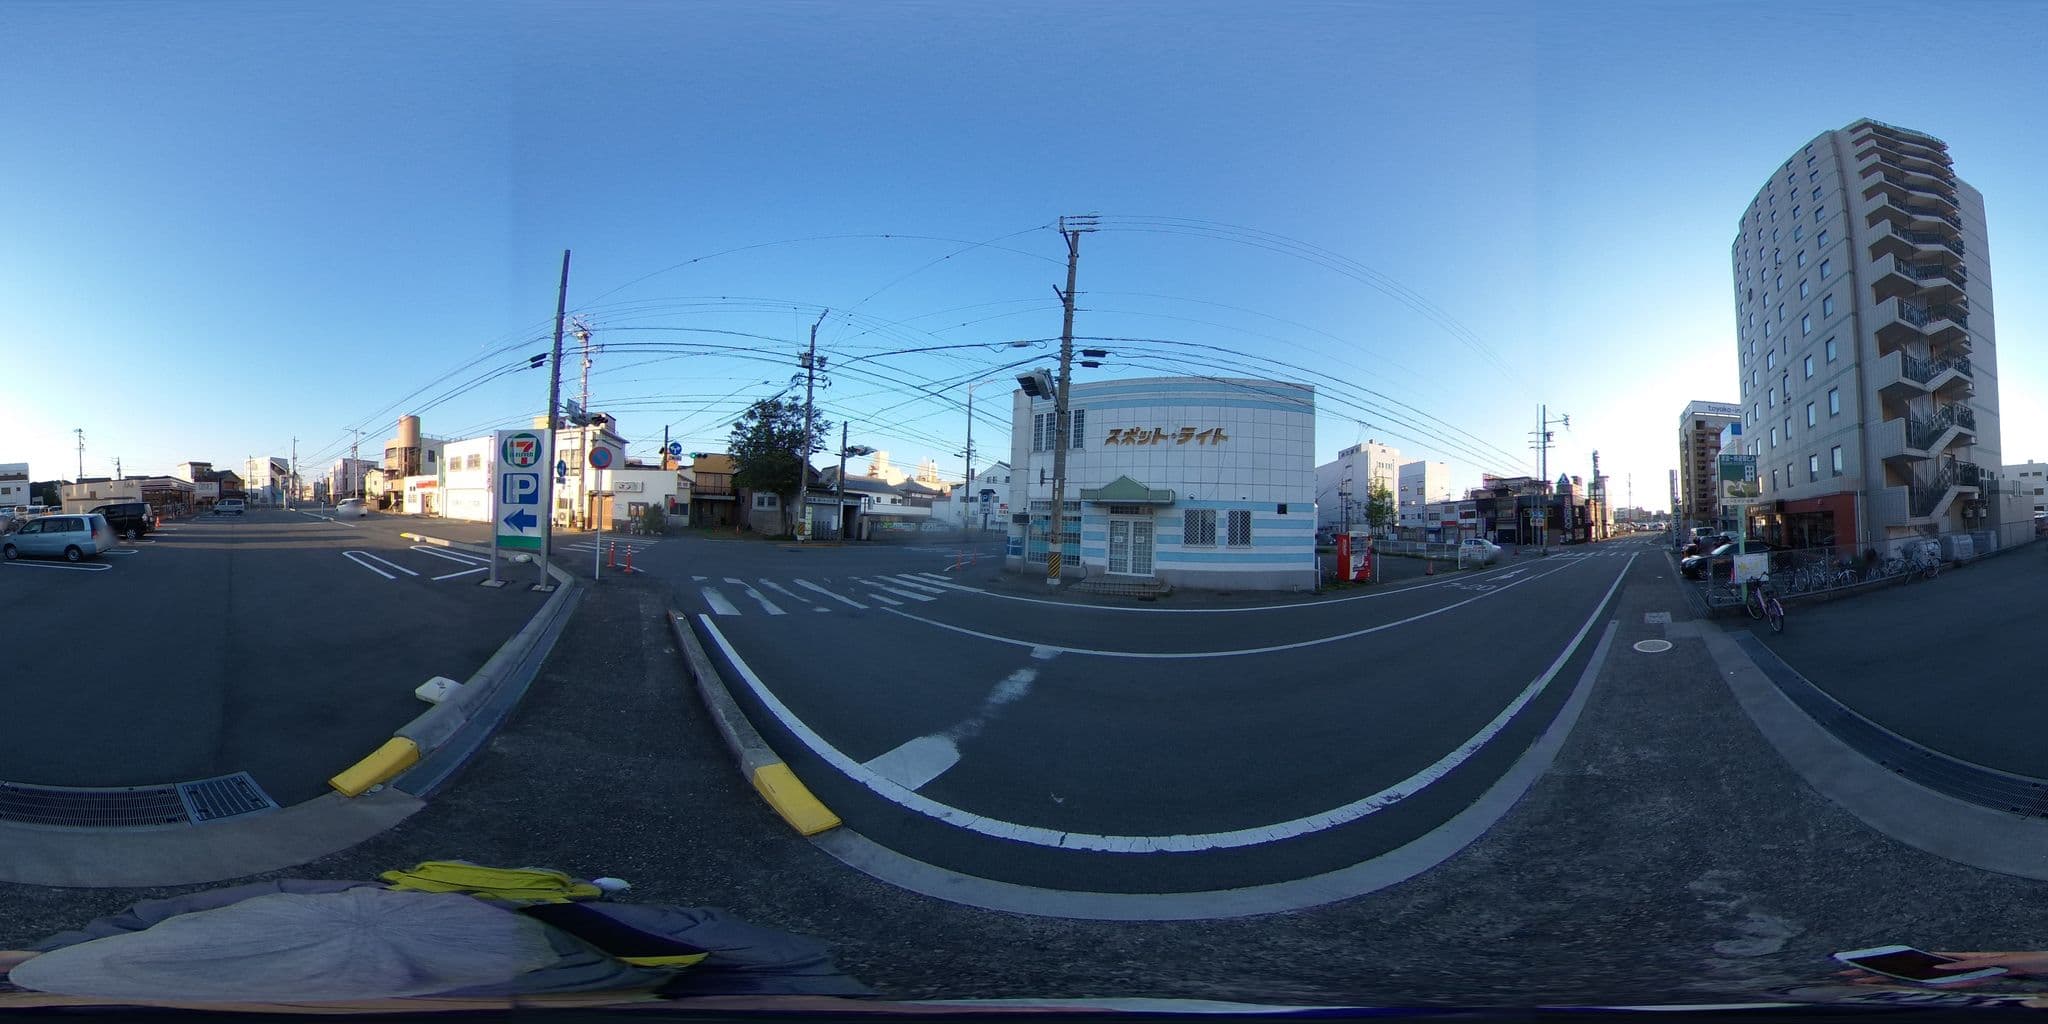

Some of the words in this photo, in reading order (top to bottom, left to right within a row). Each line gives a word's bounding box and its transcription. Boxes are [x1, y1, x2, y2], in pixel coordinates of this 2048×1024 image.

[1104, 426, 1229, 446] スポット・ライト
[506, 474, 537, 504] P
